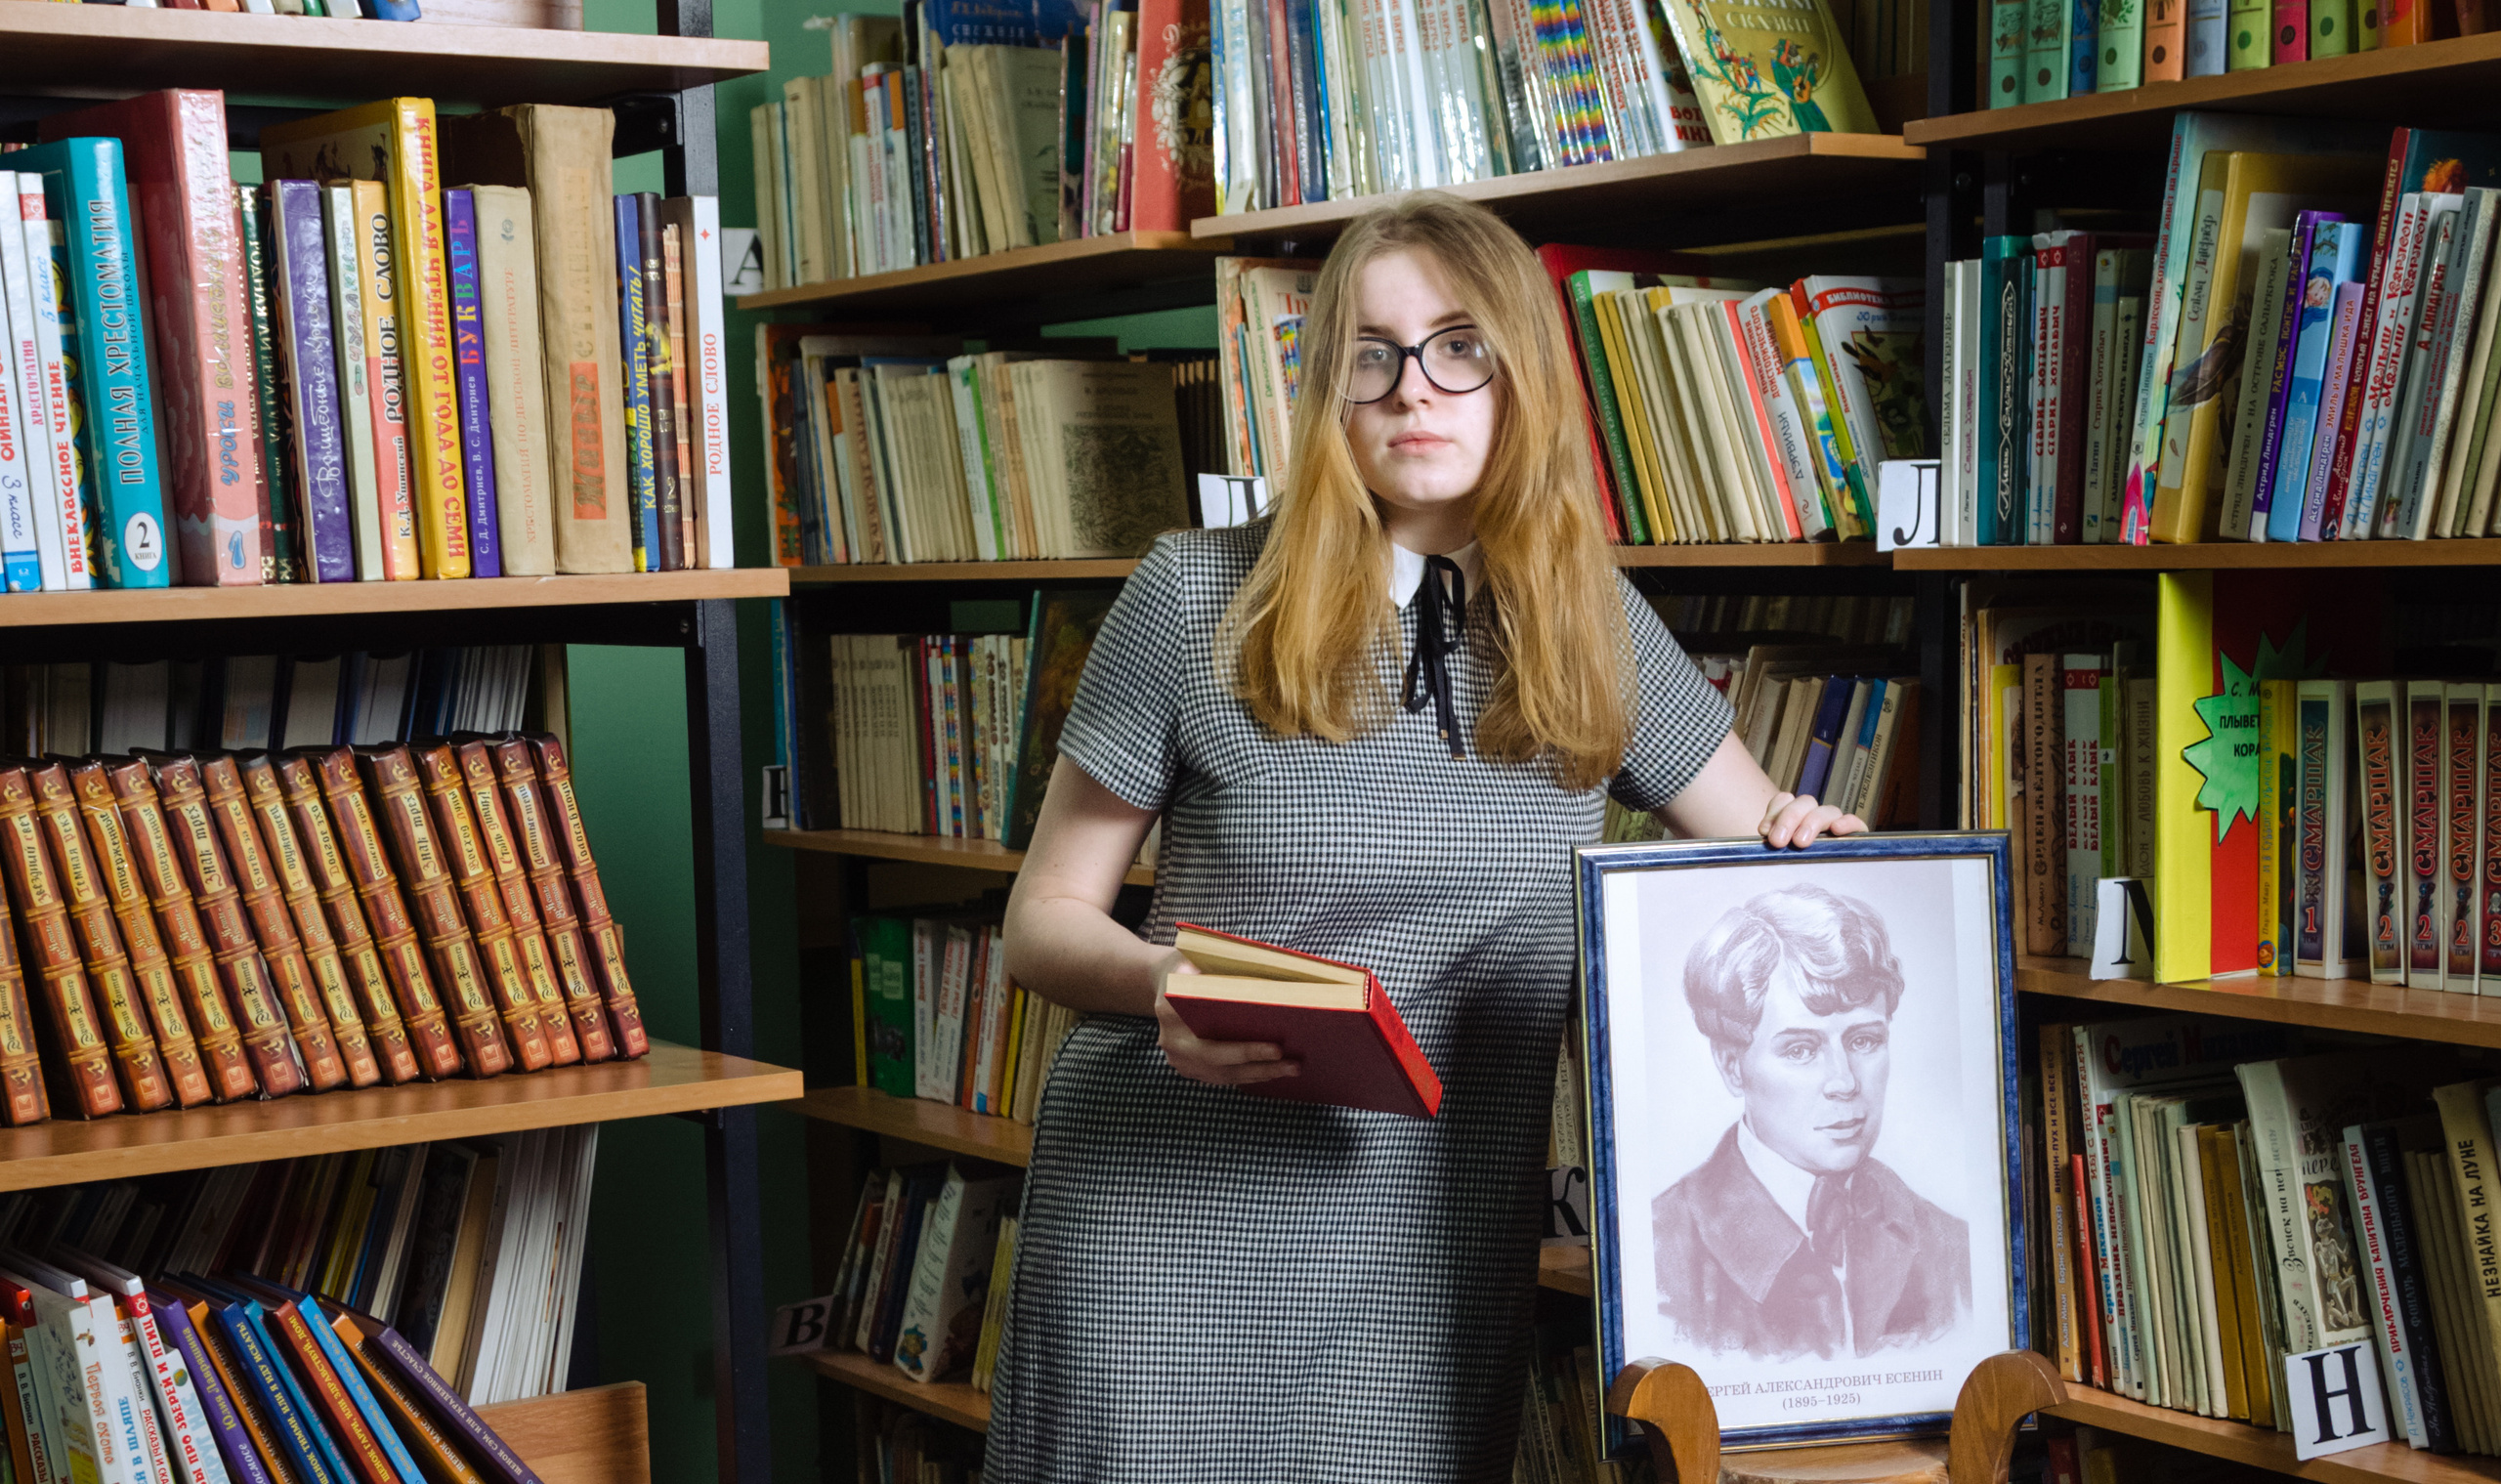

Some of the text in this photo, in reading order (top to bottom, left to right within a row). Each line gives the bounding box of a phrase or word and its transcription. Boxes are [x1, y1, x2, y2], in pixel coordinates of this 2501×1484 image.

[1724, 12, 1810, 33] СКАЗКИ
[415, 117, 436, 193] КНИГА
[41, 255, 57, 323] 5 класс
[371, 212, 404, 424] РОДНОЕ СЛОВО
[422, 257, 447, 349] ЧТЕНИЯ
[449, 218, 480, 365] БУКВАРЬ
[2138, 134, 2182, 428] Астрид Линдгрен Карлссон, который живёт на крыше
[21, 340, 44, 425] ХРЕСТОМАТИЯ
[87, 199, 146, 486] ПОЛНАЯ ХРЕСТОМАТИЯ
[120, 251, 150, 435] ДЛЯ НАЧАЛЬНОЙ ШКОЛЫ
[432, 356, 449, 385] ОТ
[1746, 321, 1768, 394] ПРИКЛЮЧЕНИЯ
[1751, 307, 1779, 398] ДОИСТОРИЧЕСКОГО
[1824, 353, 1840, 379] загадки
[306, 360, 341, 498] Волшебные
[434, 393, 453, 453] ГОДА
[504, 266, 537, 544] ХРЕСТОМАТИЯ ПО ДЕТСКОЙ ЛИТЕРАТУРЕ
[628, 266, 657, 509] КАК ХОРОШО УМЕТЬ ЧИТАТЬ!
[702, 332, 724, 476] РОДНОЕ СЛОВО
[1832, 380, 1849, 413] Лесные
[2230, 258, 2277, 530] АСТРИД ЛИНДГРЕН НА ОСТРОВЕ САЛЬТКРОКА
[2257, 462, 2269, 500] Астрид
[2263, 408, 2276, 459] Линдгрен
[2272, 348, 2287, 392] РАСМУС,
[2281, 303, 2294, 339] ПОНТУС
[2288, 286, 2296, 296] И
[2310, 300, 2353, 522] Астрид Линдгрен ЭМИЛЬ И МАЛЫШКА ИДА
[47, 360, 84, 573] ВНЕКЛАССНОЕ ЧТЕНИЕ
[395, 436, 411, 538] К.Д. Ушинский
[439, 459, 458, 490] ДО
[135, 551, 158, 561] КНИГА
[136, 521, 150, 549] 2
[444, 498, 465, 558] СЕМИ
[2138, 700, 2149, 747] ЖИЗНИ
[2138, 771, 2151, 821] ЛЮБОВЬ
[97, 814, 131, 897] Отверженные
[186, 806, 221, 890] Знак трех
[2066, 740, 2077, 943] Джек Лондон БЕЛЫЙ КЛЫК
[2303, 936, 2317, 945] ТОМ
[2304, 907, 2317, 935] 1
[2378, 914, 2394, 941] 2
[60, 981, 94, 1045] Эрин Хантер
[1542, 1166, 1589, 1237] К
[2075, 1043, 2116, 1324] Сергей Михалков МЫ С ПРИЯТЕЛЕМ
[2114, 1195, 2128, 1251] Непослушания
[2458, 1140, 2500, 1297] НЕЗНАЙКА НА ЛУНЕ
[2056, 1205, 2065, 1248] Заходер
[2350, 1144, 2400, 1352] ПРИКЛЮЧЕНИЯ КАПИТАНА ВРУНГЕЛЯ
[2121, 1253, 2133, 1290] Праздник
[784, 1303, 825, 1347] В
[2131, 1335, 2141, 1361] Сергей
[86, 1362, 113, 1463] Первая охота
[144, 1320, 198, 1463] ПРО ЗВЕРЕЙ И ПТИЦ
[184, 1328, 235, 1429] Юлия Лавряшина
[237, 1323, 310, 1452] ТИММИ, ИЛИ Я ИДУ ИСКАТЬ!
[289, 1316, 390, 1481] ЩЕНОК ГАРРИ, ИЛИ ЗДРАВСТВУЙ, ДОМ!
[393, 1340, 522, 1475] ЩЕНОК СЭМ, ИЛИ УКРАДЕННОЕ СЧАСТЬЕ
[1706, 1369, 1944, 1397] ЕРГЕЙ АЛЕКСАНДРОВИЧ ЕСЕНИН
[2302, 1345, 2376, 1445] Н
[18, 1373, 47, 1482] В. В. Бианки РАССКАЗЫ
[119, 1397, 143, 1465] В ШЛЯПЕ
